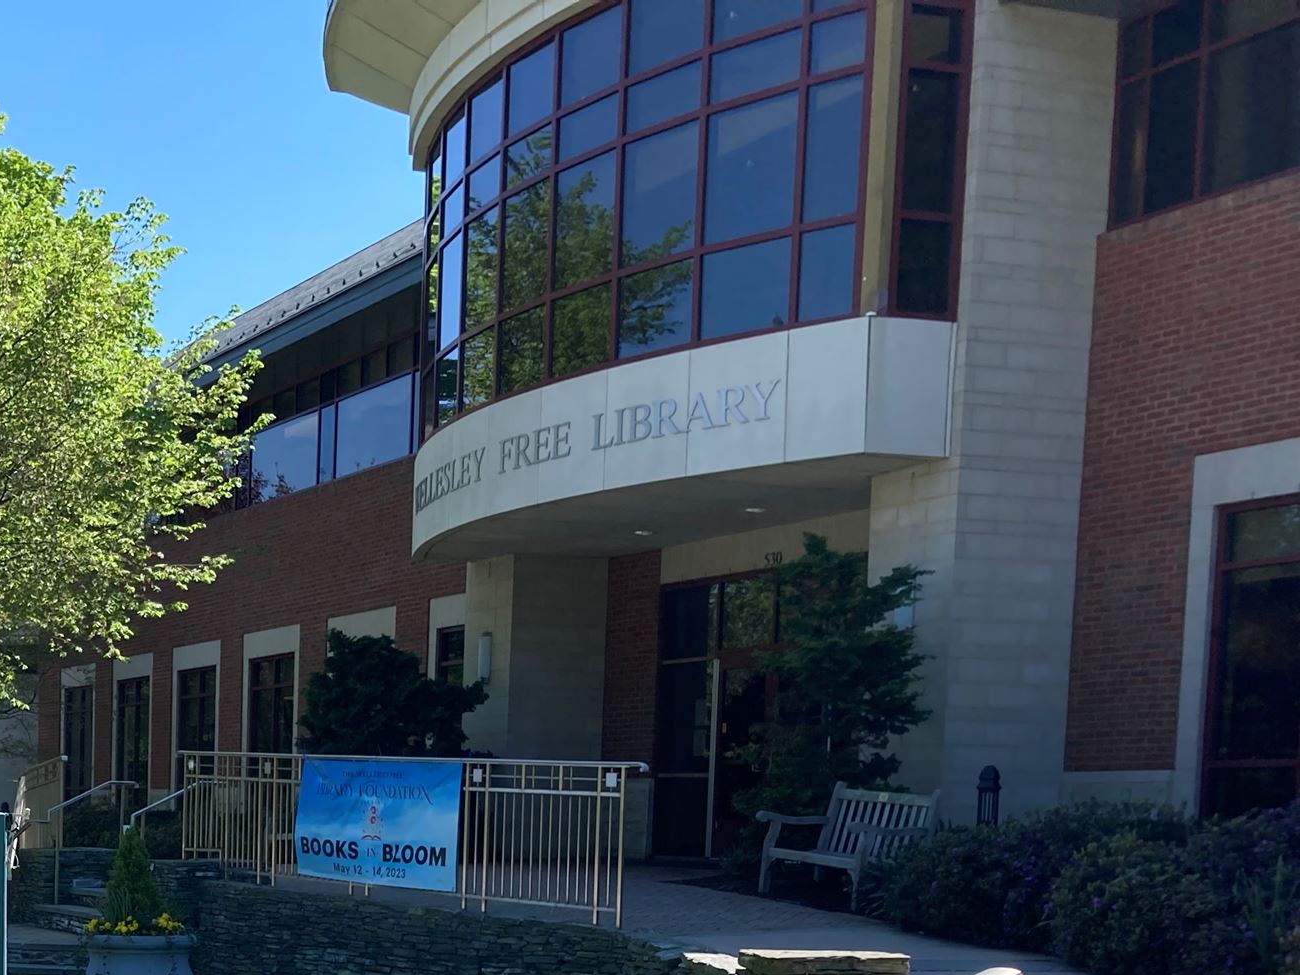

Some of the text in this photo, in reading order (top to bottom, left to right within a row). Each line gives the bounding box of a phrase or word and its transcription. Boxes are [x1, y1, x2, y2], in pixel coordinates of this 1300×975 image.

[498, 421, 572, 475] FREE
[590, 378, 782, 452] LIBRARY
[764, 551, 783, 568] 530
[317, 782, 433, 805] LIBRARY FOUNDATION
[300, 836, 447, 867] BOOKS IN BLOOM
[333, 863, 350, 875] May
[353, 865, 363, 876] 12
[372, 866, 383, 878] 14,
[385, 867, 406, 879] 2023
